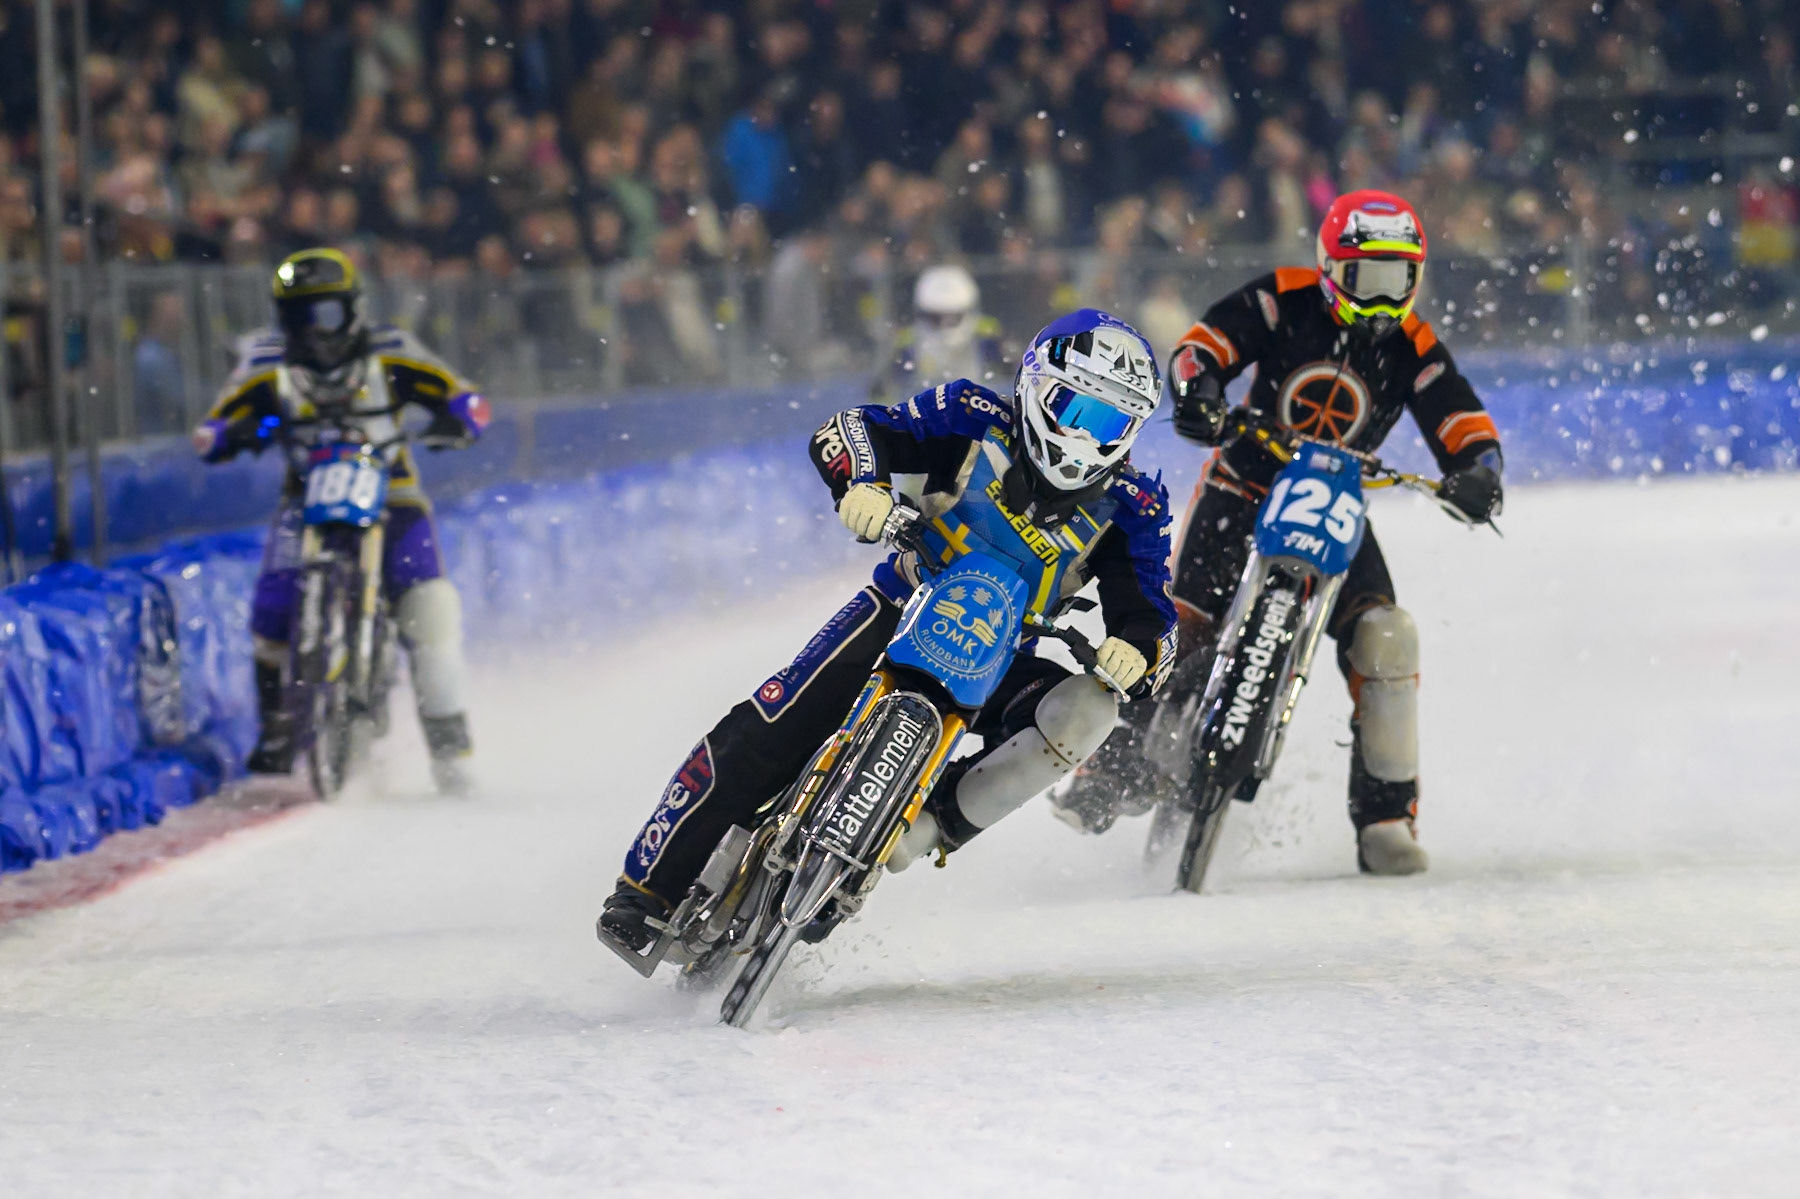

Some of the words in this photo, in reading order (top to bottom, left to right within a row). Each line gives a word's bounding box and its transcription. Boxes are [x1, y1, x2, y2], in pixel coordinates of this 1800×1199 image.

[1262, 477, 1363, 544] 125
[1284, 531, 1325, 555] FIM
[932, 617, 978, 656] ÖMK
